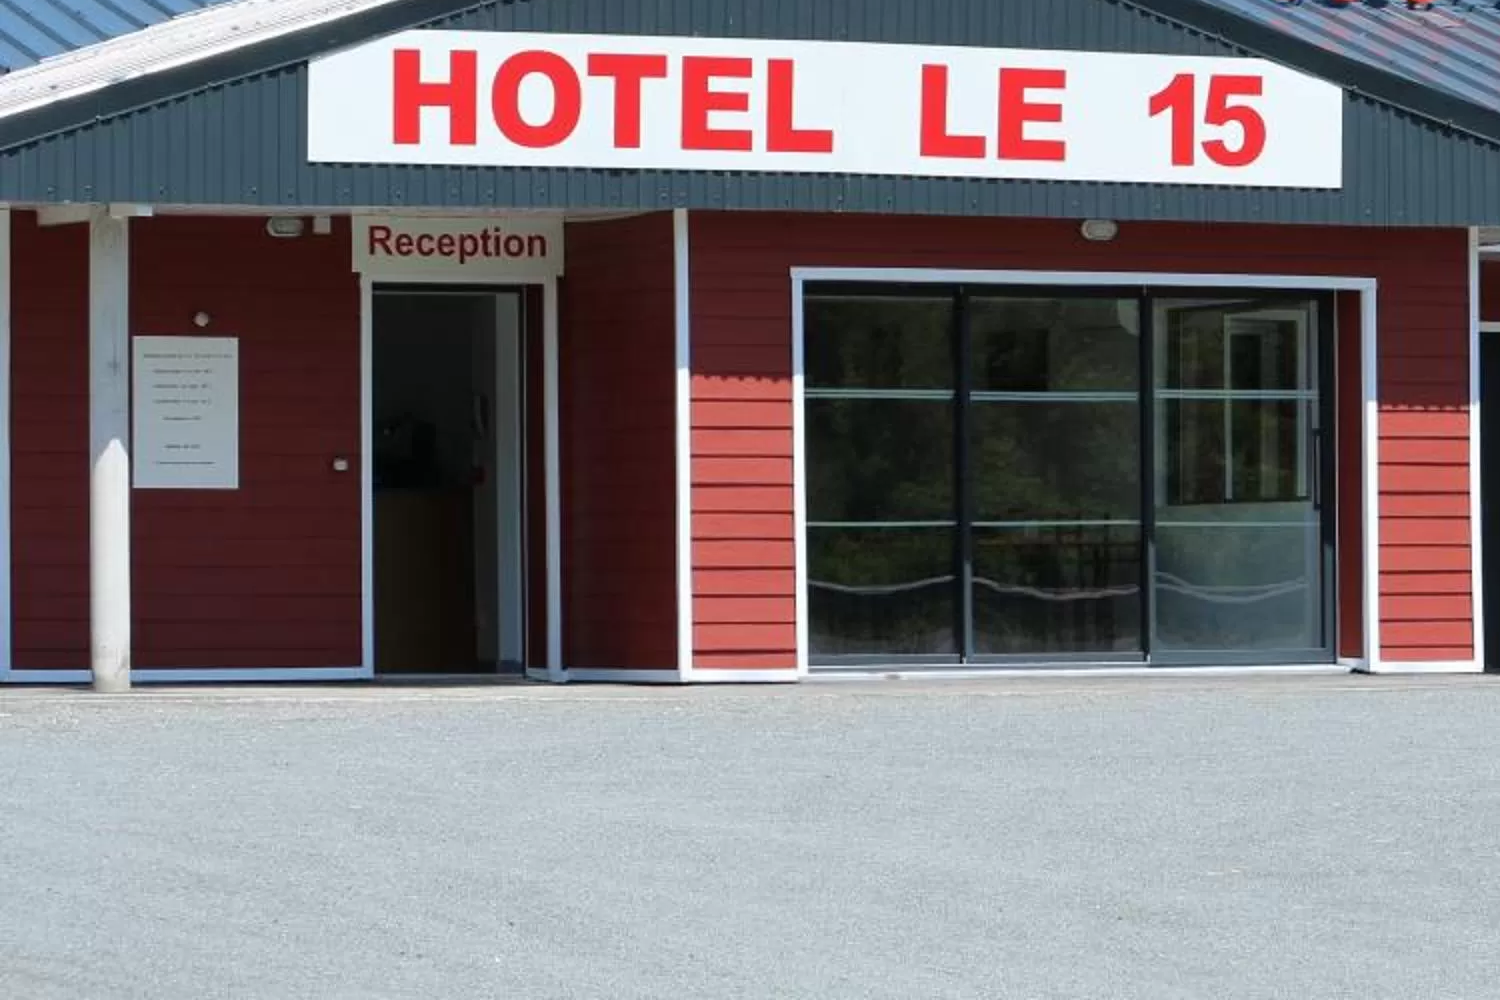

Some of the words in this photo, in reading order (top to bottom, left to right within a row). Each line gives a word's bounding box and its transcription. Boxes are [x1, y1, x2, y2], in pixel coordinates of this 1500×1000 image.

[393, 49, 834, 153] HOTEL
[920, 64, 1066, 161] LE
[1149, 73, 1266, 168] 15
[367, 224, 547, 264] Reception
